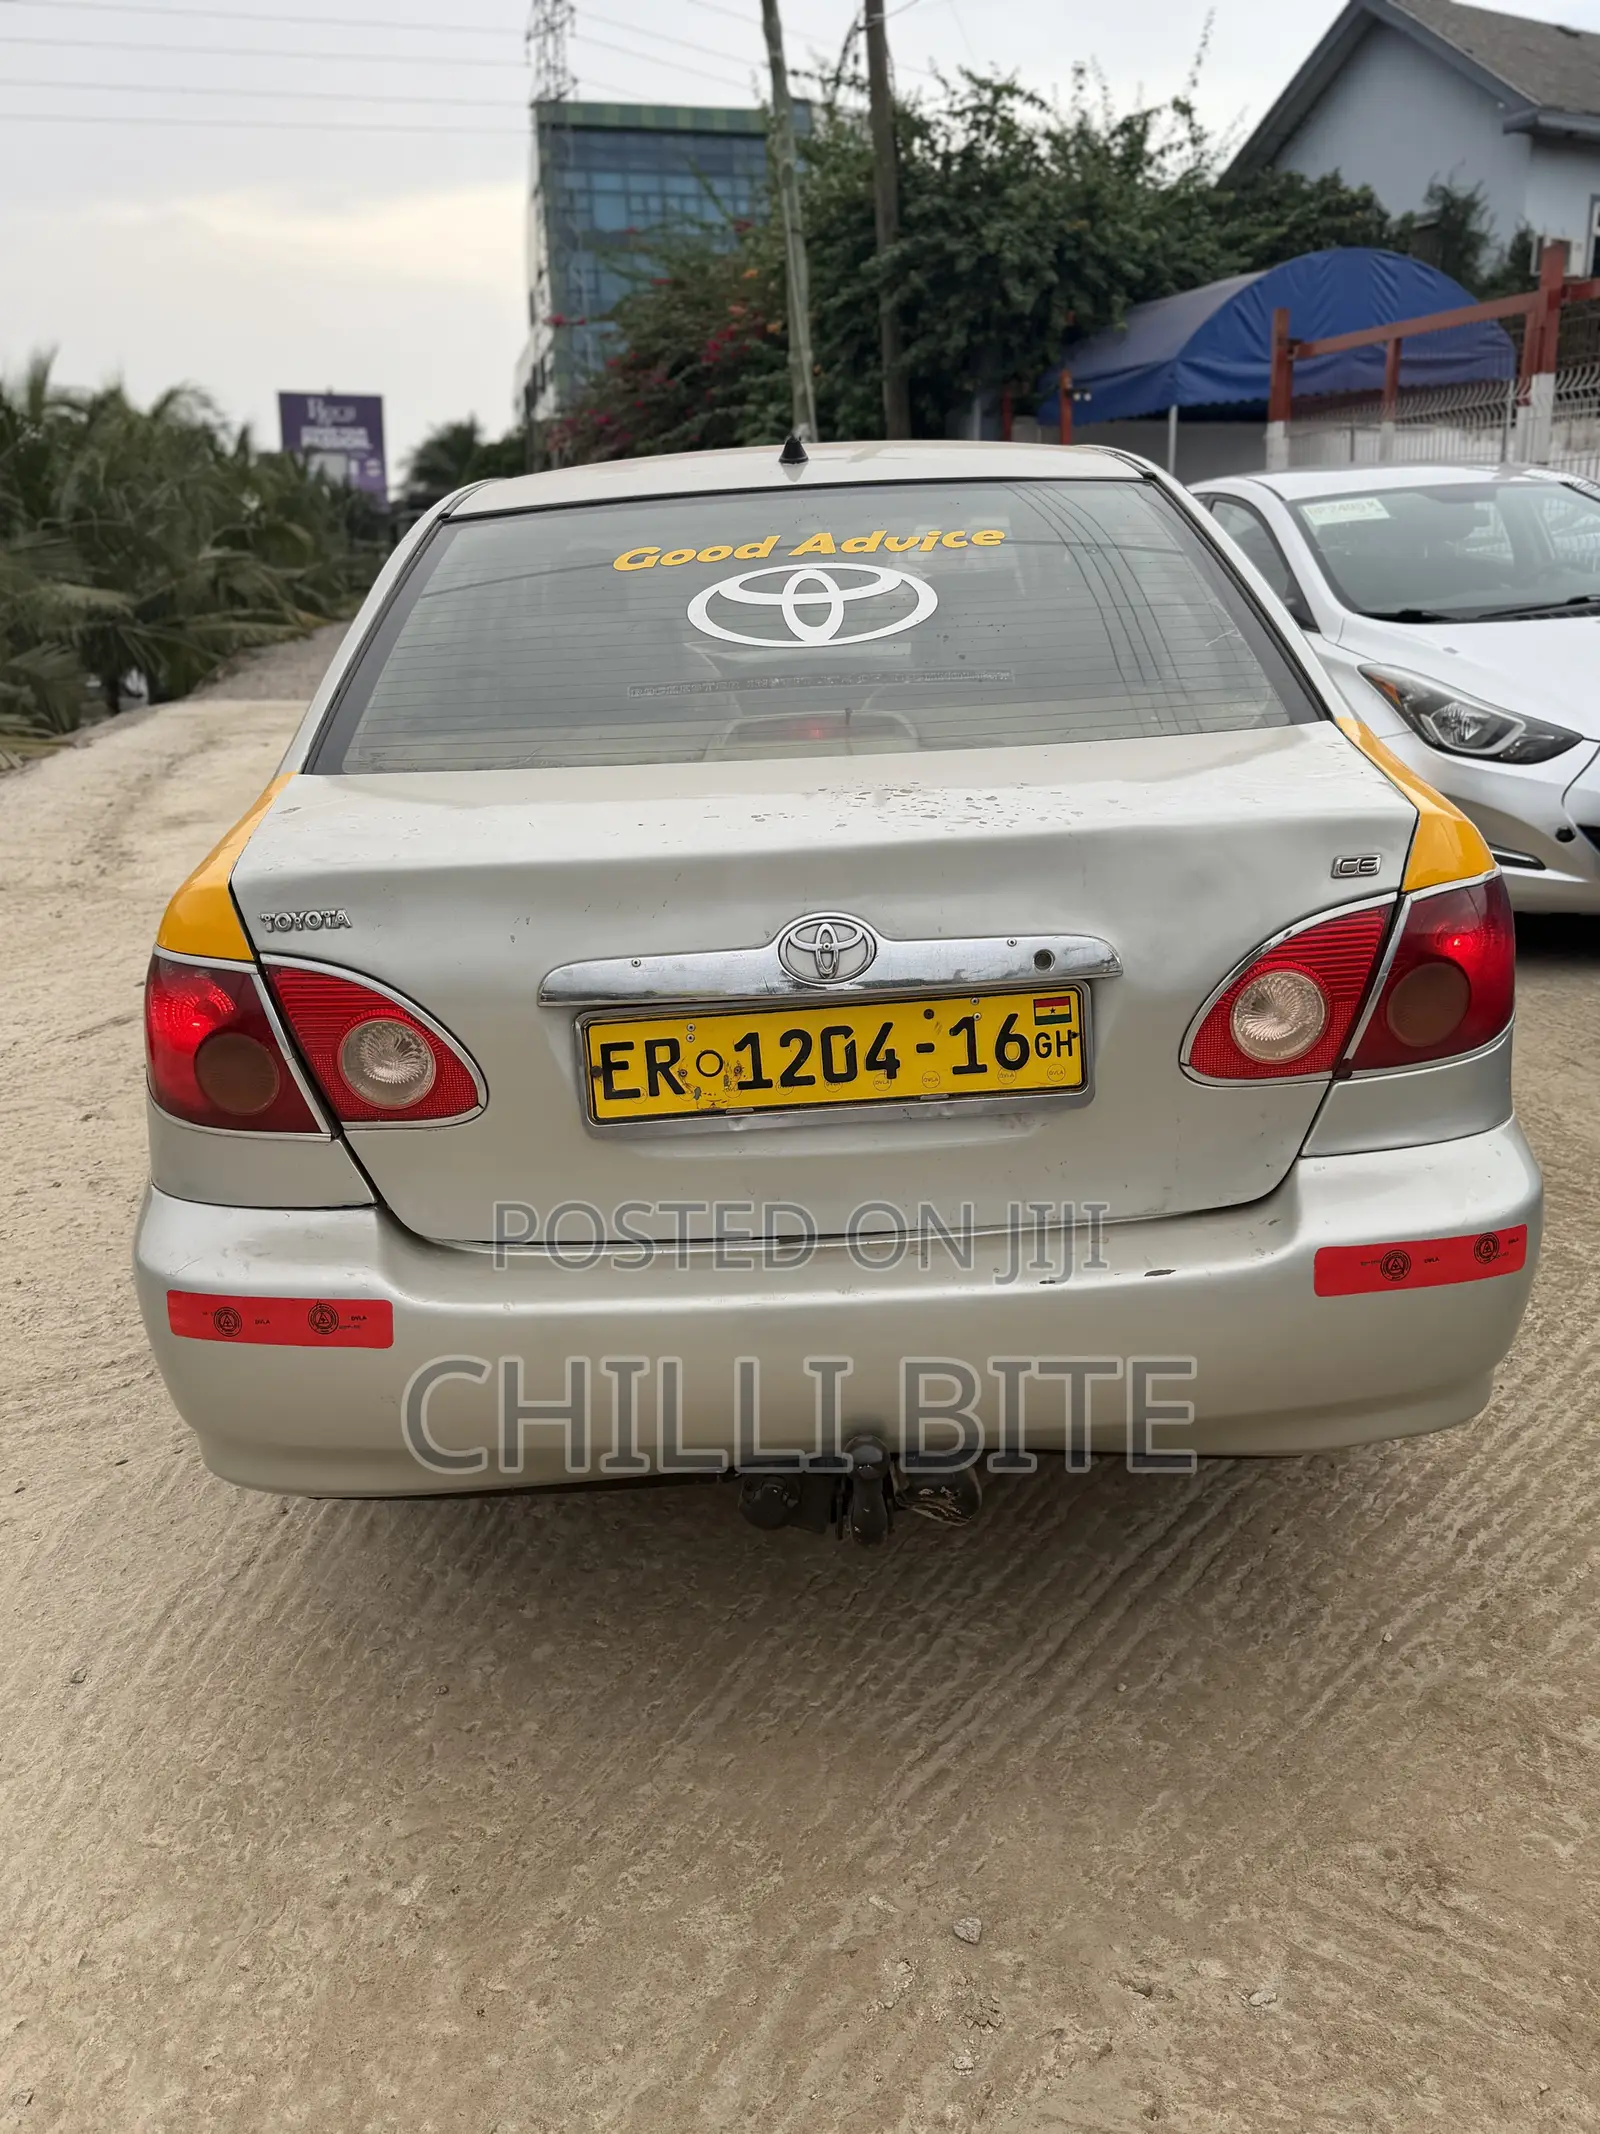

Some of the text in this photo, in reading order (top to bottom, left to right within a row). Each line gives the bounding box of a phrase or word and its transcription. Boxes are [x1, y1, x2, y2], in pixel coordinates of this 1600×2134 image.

[612, 529, 1005, 571] Good Advice
[1339, 857, 1379, 875] CE
[259, 909, 352, 932] TOYOTA
[1034, 1029, 1073, 1059] GH
[601, 1037, 686, 1101] ER
